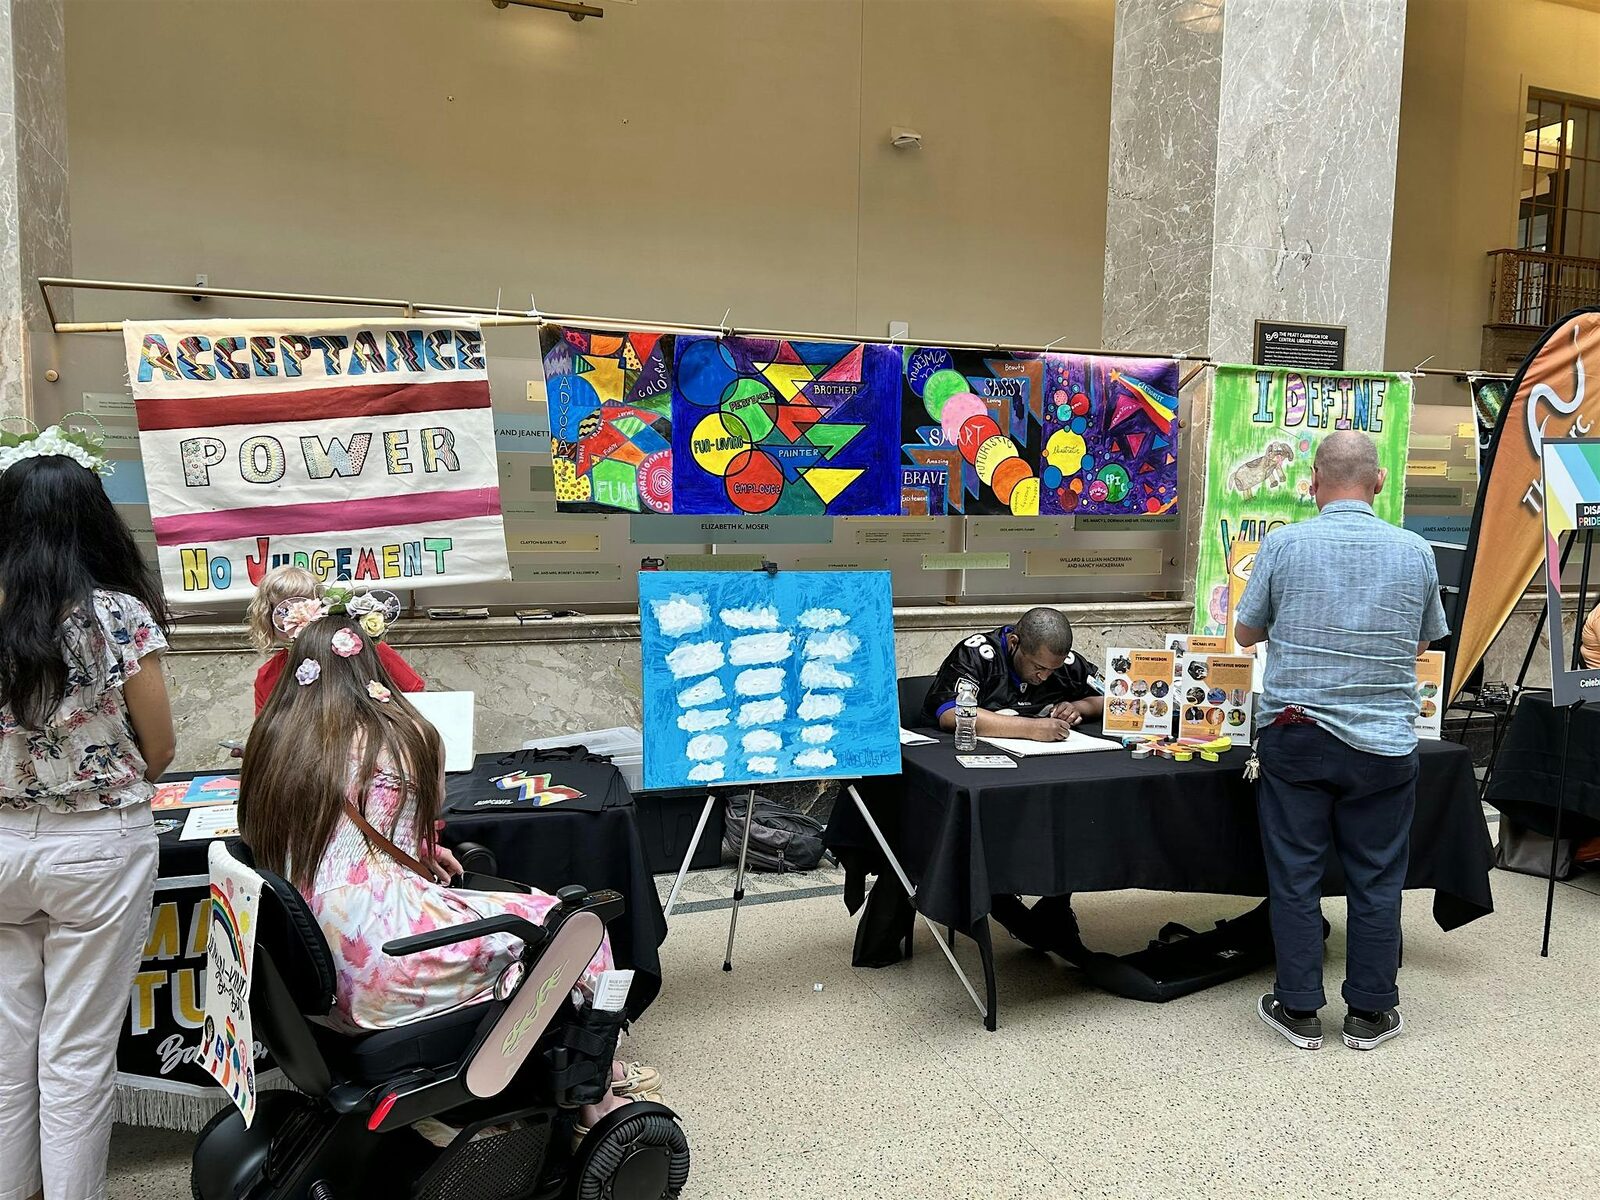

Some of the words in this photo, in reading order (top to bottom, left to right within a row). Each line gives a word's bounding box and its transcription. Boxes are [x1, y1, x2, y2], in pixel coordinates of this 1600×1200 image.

[138, 330, 486, 382] ACCEPTANCE
[813, 384, 858, 395] BROTHER
[983, 377, 1026, 397] SASSY
[1253, 371, 1274, 423] I
[1284, 373, 1386, 433] DEFINE
[518, 430, 550, 438] JEANETT
[929, 424, 985, 447] SMART
[693, 436, 744, 454] FUN-LOVING
[778, 448, 819, 457] PAINTER
[180, 427, 460, 488] POWER
[926, 458, 949, 466] Amazing
[976, 436, 1013, 478] FUTURISTIC
[904, 471, 948, 485] BRAVE
[595, 480, 637, 506] FUN
